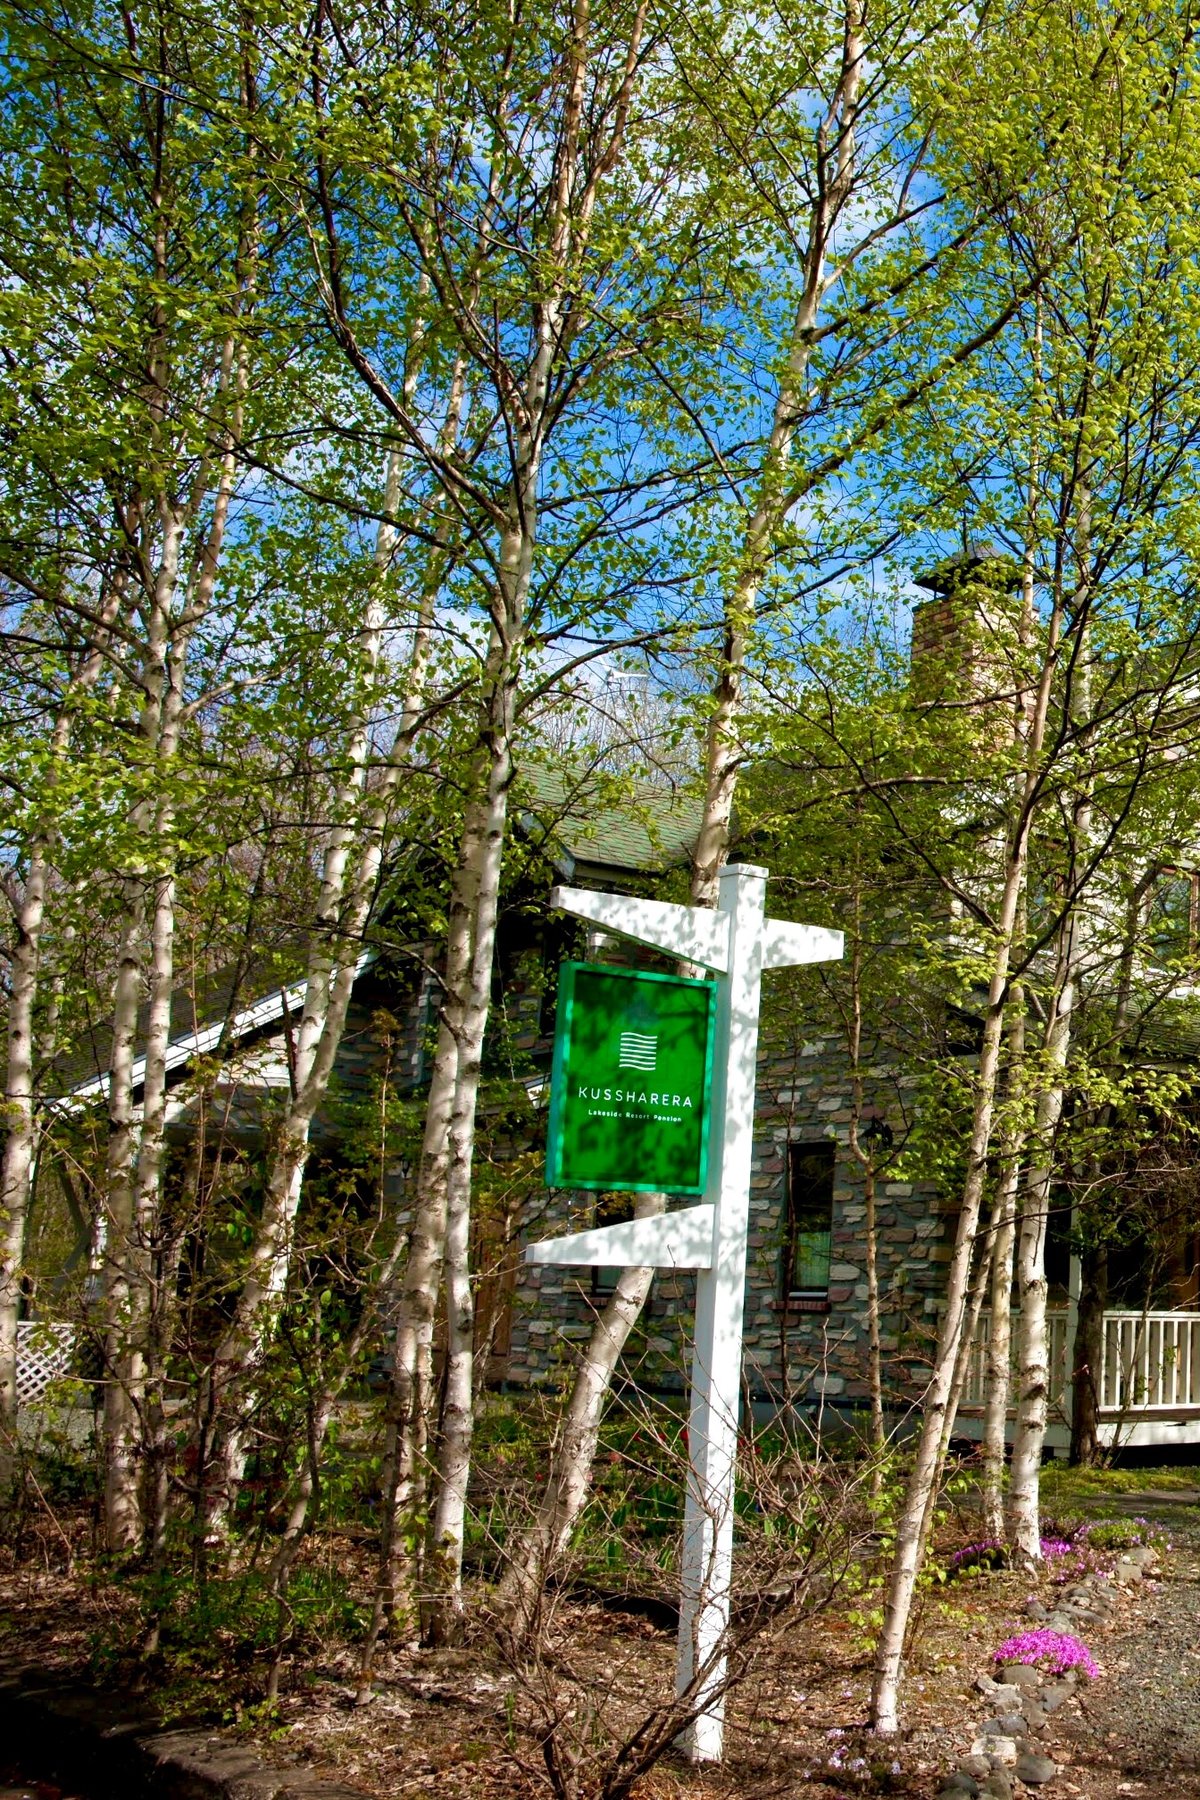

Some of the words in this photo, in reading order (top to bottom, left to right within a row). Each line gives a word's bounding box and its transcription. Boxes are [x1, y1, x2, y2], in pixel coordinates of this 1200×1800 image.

[578, 1086, 692, 1108] KUSSHARERA
[588, 1109, 622, 1118] Lakeside
[625, 1112, 650, 1120] Resort
[653, 1114, 682, 1122] Pension
